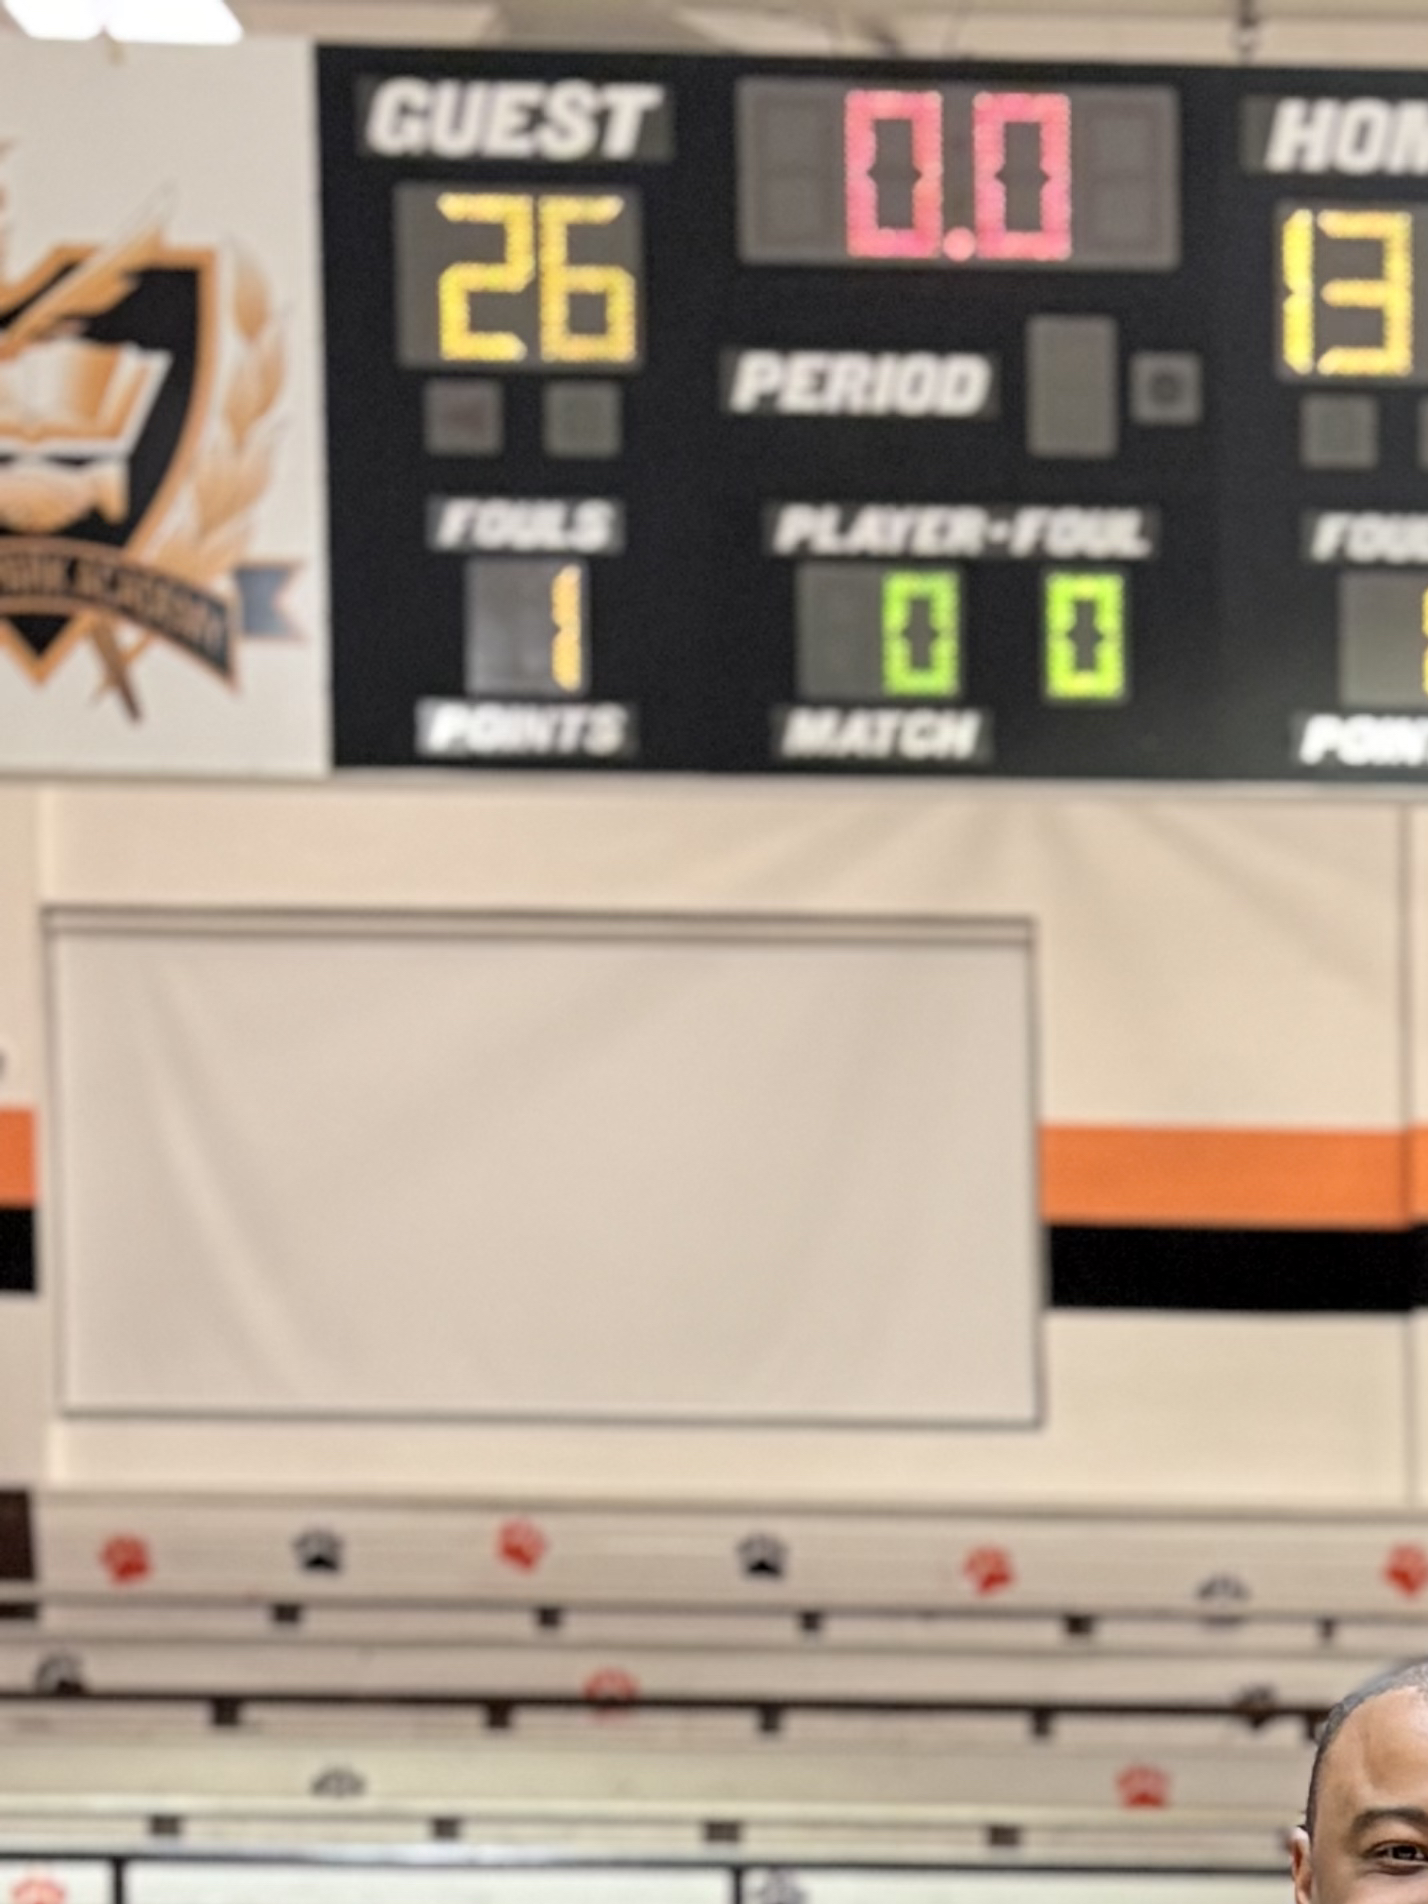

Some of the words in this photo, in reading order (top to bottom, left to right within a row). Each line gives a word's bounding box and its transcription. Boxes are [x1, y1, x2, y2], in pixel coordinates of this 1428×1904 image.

[365, 77, 663, 158] GUEST
[438, 193, 636, 362] 26
[731, 353, 991, 414] PERIOD
[438, 501, 613, 550] FOULS
[552, 565, 582, 690] 1
[883, 572, 958, 696] 0
[1047, 574, 1124, 698] 0
[425, 706, 627, 756] POINTS
[783, 711, 981, 759] MATCH
